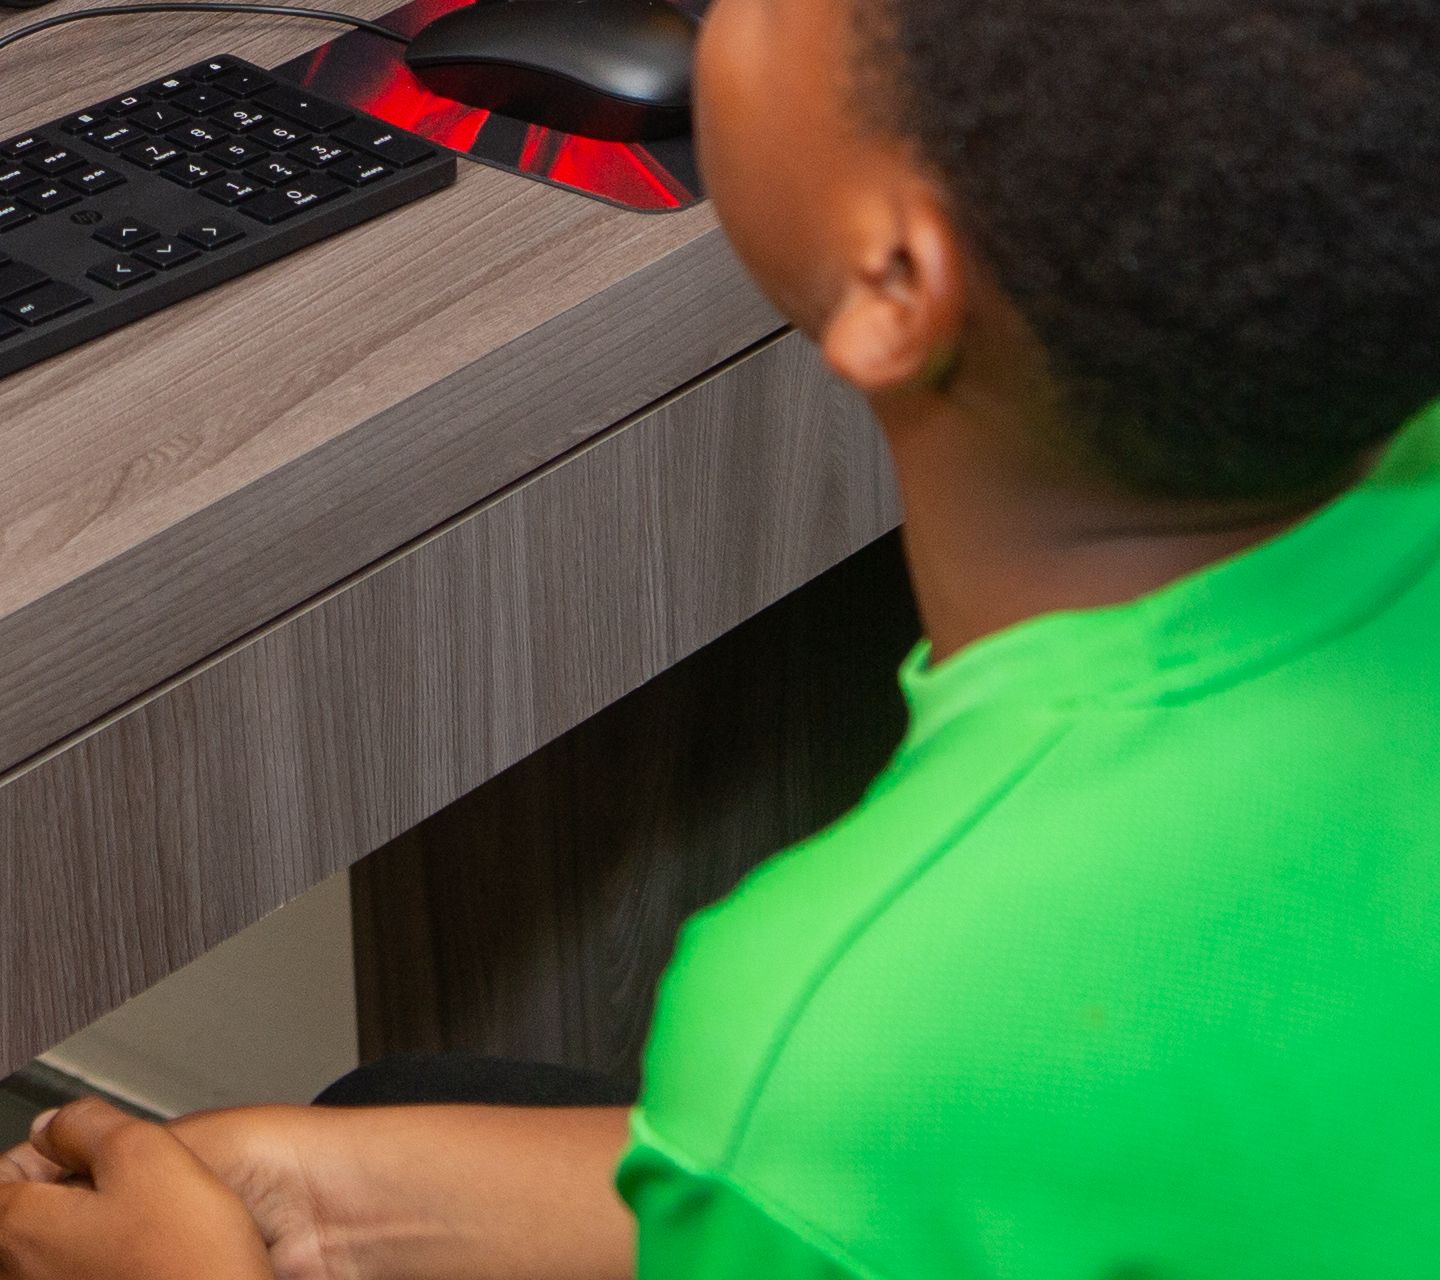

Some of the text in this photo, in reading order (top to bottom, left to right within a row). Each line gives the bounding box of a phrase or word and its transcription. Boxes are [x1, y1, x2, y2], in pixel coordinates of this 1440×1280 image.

[145, 111, 248, 155] 7 8 9
[189, 128, 288, 173] 4 5 6
[226, 182, 240, 190] 1
[269, 163, 284, 173] 2
[311, 145, 327, 154] 3
[286, 190, 303, 199] 0
